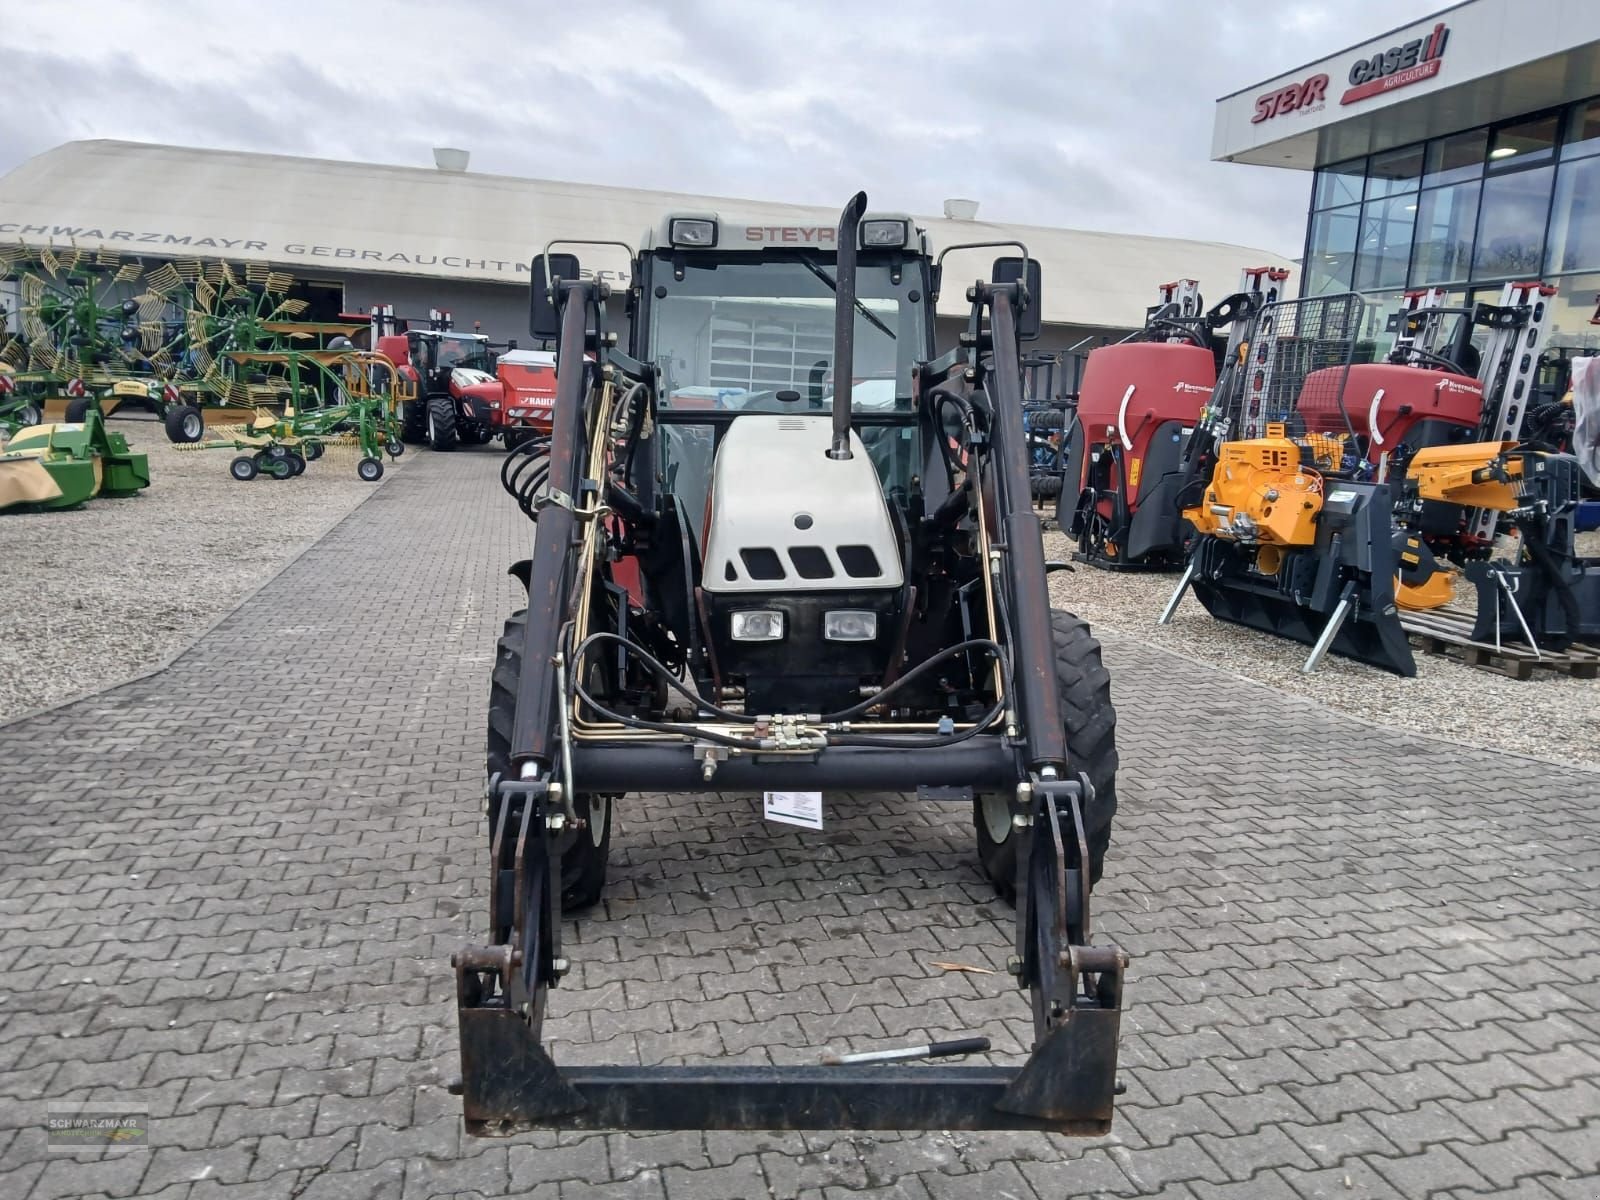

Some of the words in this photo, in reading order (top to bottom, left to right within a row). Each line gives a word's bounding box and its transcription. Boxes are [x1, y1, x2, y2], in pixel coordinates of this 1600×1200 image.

[1349, 38, 1422, 86] CASE
[1383, 63, 1435, 89] AGRICULTURE
[1251, 73, 1330, 124] STEYR
[745, 226, 836, 243] STEYR
